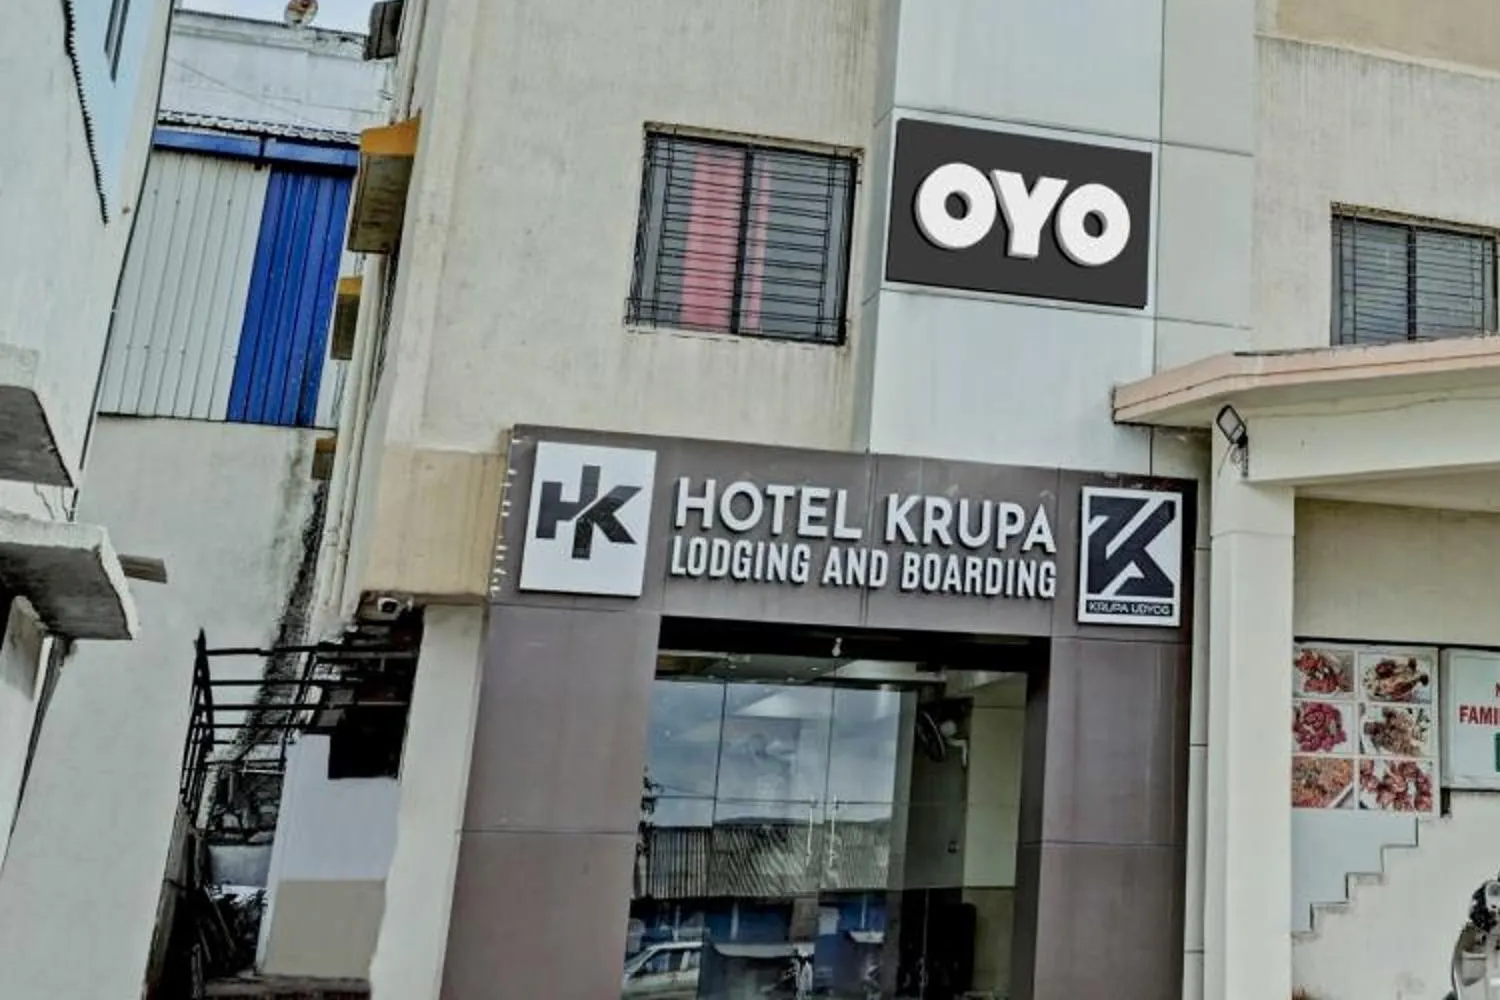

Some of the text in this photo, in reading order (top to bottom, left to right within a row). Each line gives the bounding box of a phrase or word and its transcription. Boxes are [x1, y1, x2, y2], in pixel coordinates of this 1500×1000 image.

[914, 161, 1131, 267] OYO
[675, 476, 1057, 553] HOTEL KRUPA
[671, 535, 1057, 599] LODGING AND BOARDING
[1088, 602, 1129, 614] KRUPA
